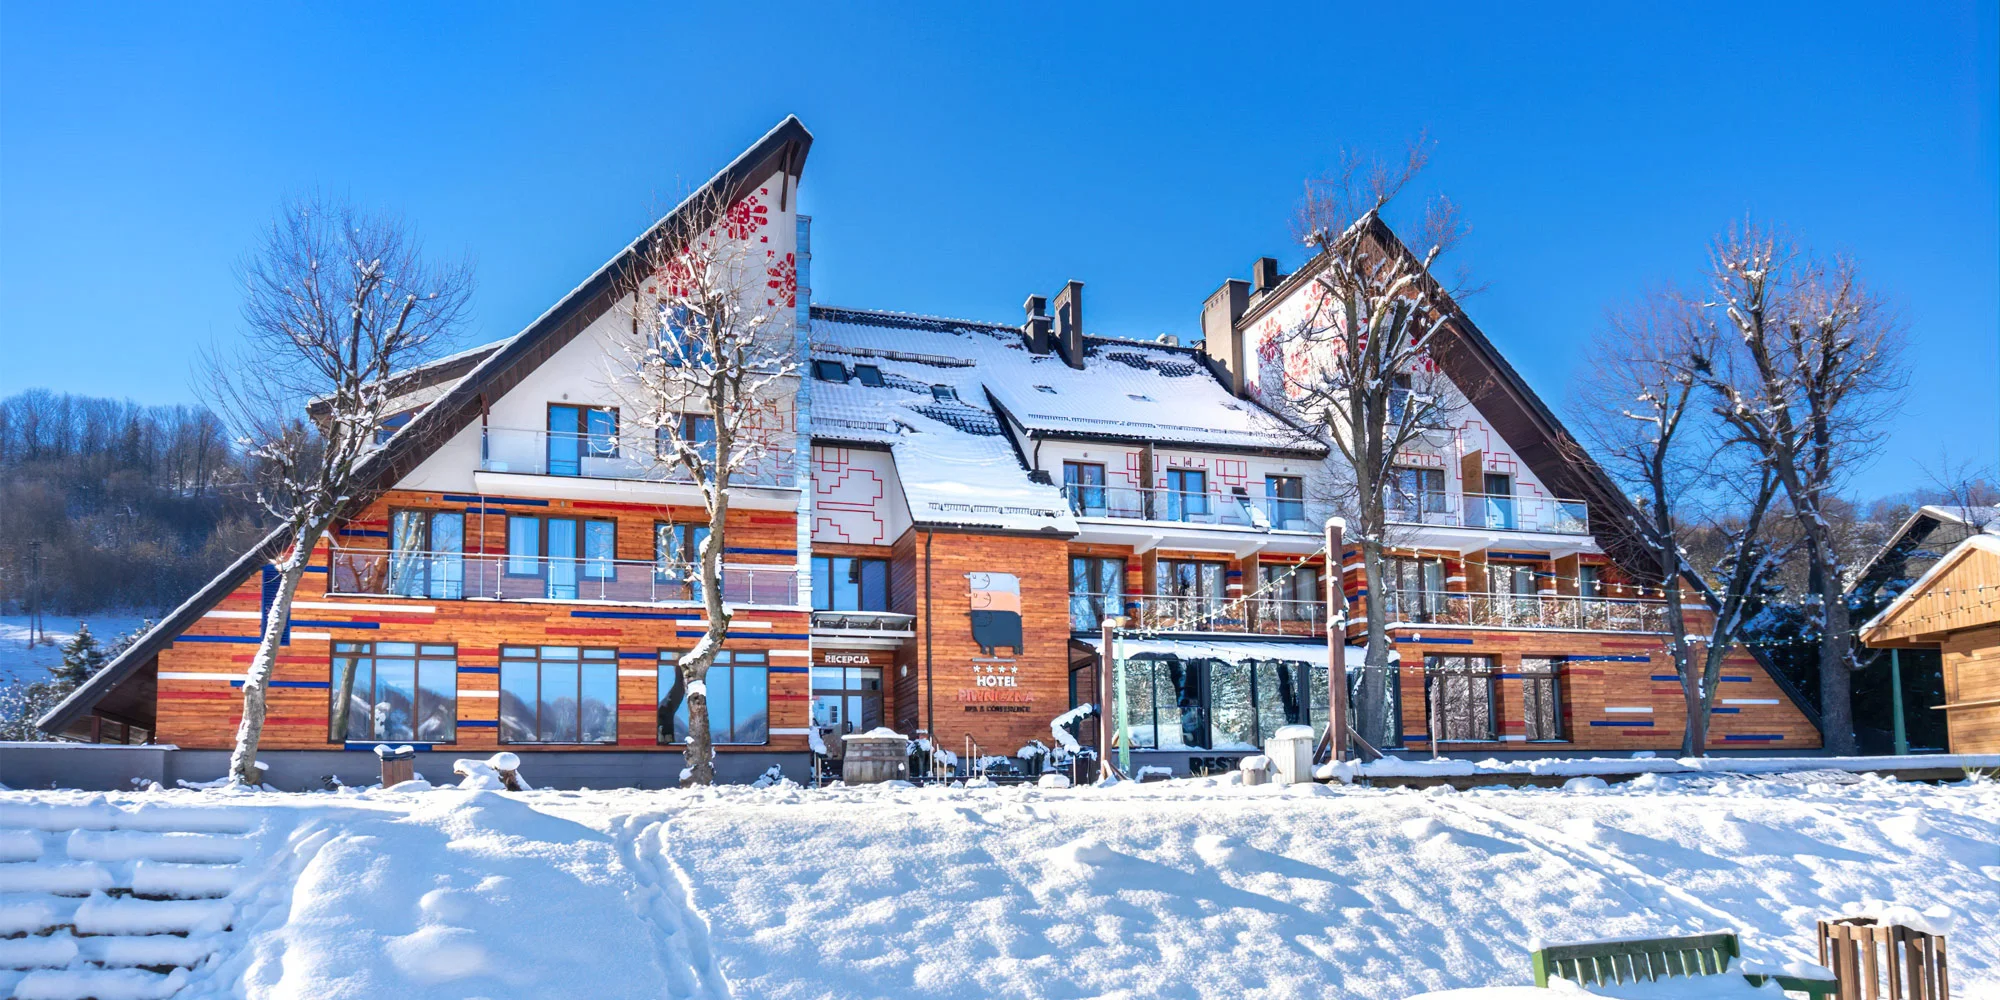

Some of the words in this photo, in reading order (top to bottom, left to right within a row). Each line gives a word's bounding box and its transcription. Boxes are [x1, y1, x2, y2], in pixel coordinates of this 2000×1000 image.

[825, 655, 870, 664] RECEPCJA
[976, 675, 1018, 687] HOTEL
[958, 689, 1034, 702] PIWNICZNA
